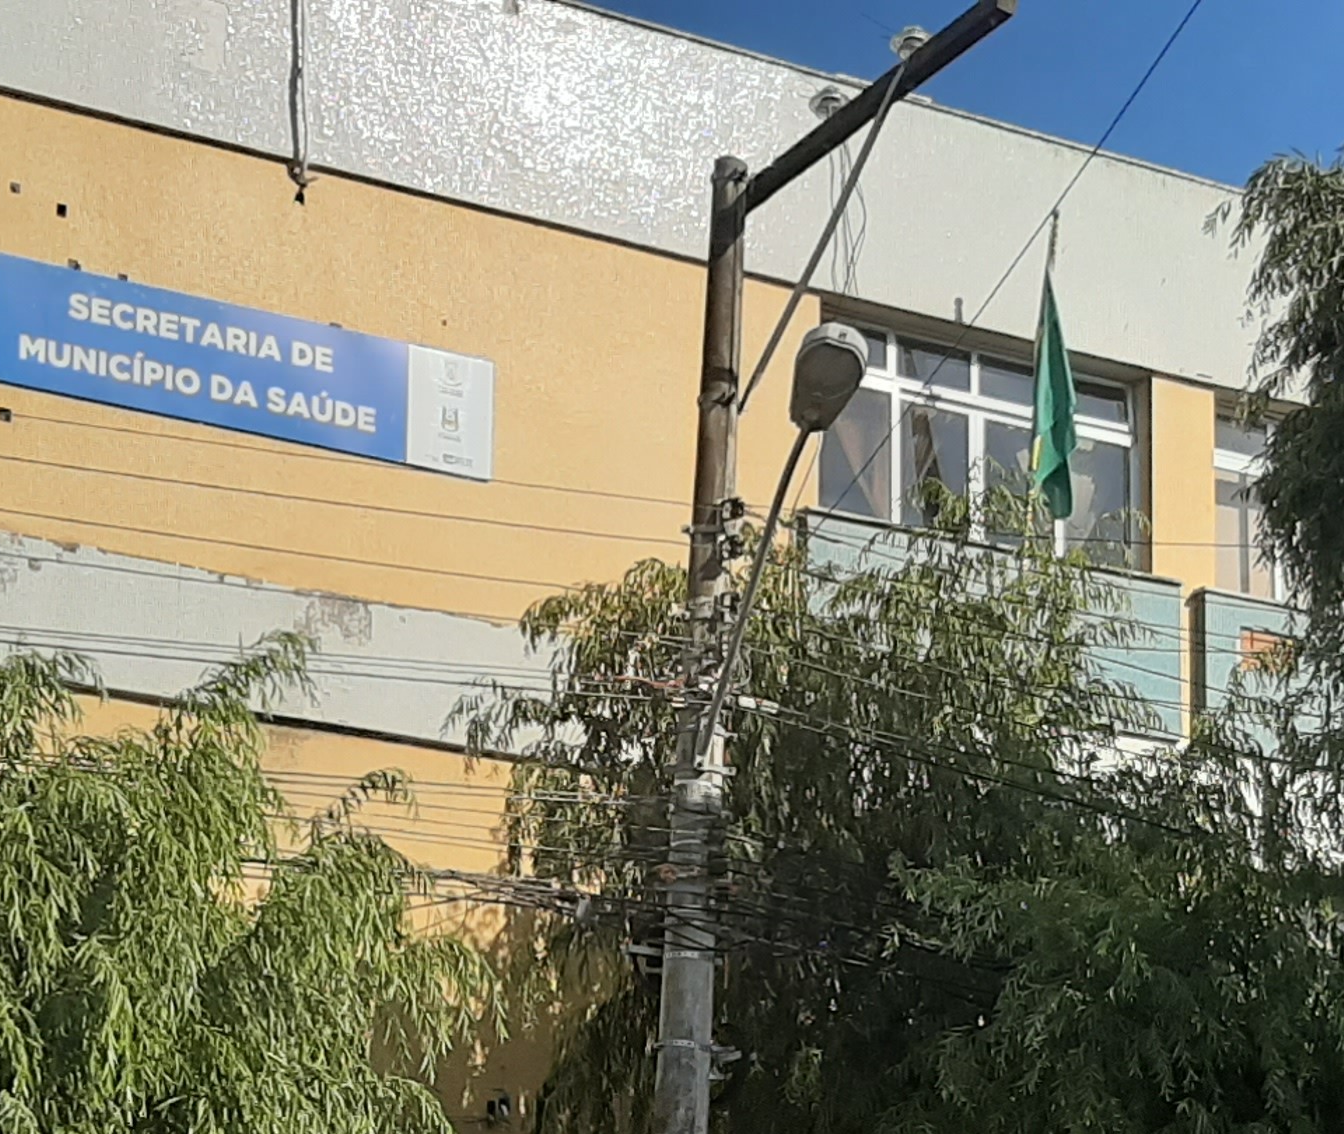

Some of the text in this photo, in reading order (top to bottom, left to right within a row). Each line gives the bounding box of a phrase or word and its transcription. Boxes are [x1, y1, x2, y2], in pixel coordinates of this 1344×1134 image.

[67, 293, 334, 373] SECRETARIA DE
[18, 333, 377, 433] MUNICÍPIO DA SAÚDE
